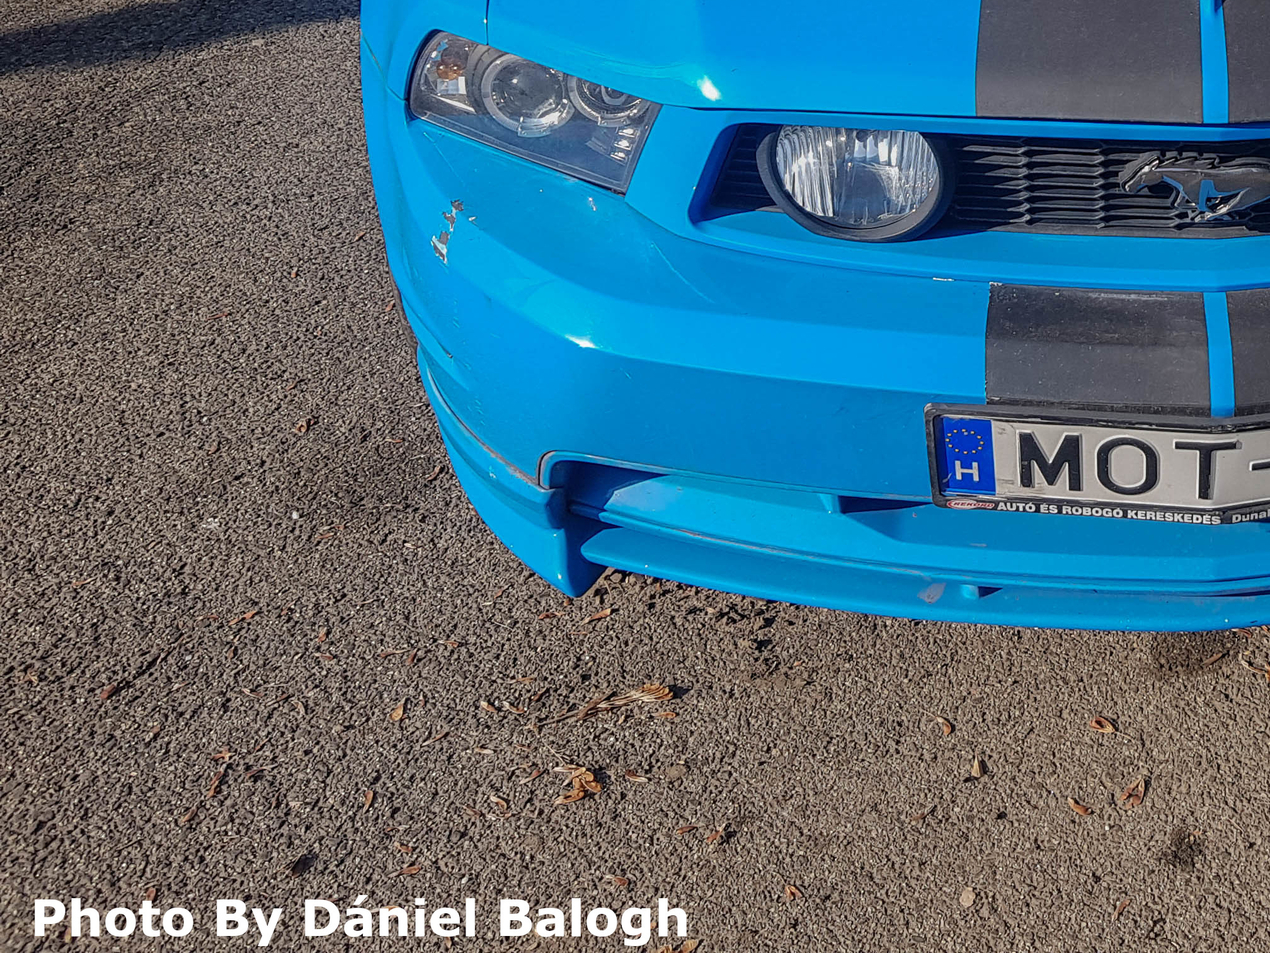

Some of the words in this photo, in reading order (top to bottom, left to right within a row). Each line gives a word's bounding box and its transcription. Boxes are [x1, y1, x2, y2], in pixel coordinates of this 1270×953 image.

[954, 460, 980, 483] H
[996, 501, 1036, 513] AUTÓ
[1040, 502, 1058, 515] ÉS
[1062, 504, 1124, 519] ROBOGÓ
[1127, 509, 1222, 526] KERESKEDÉS
